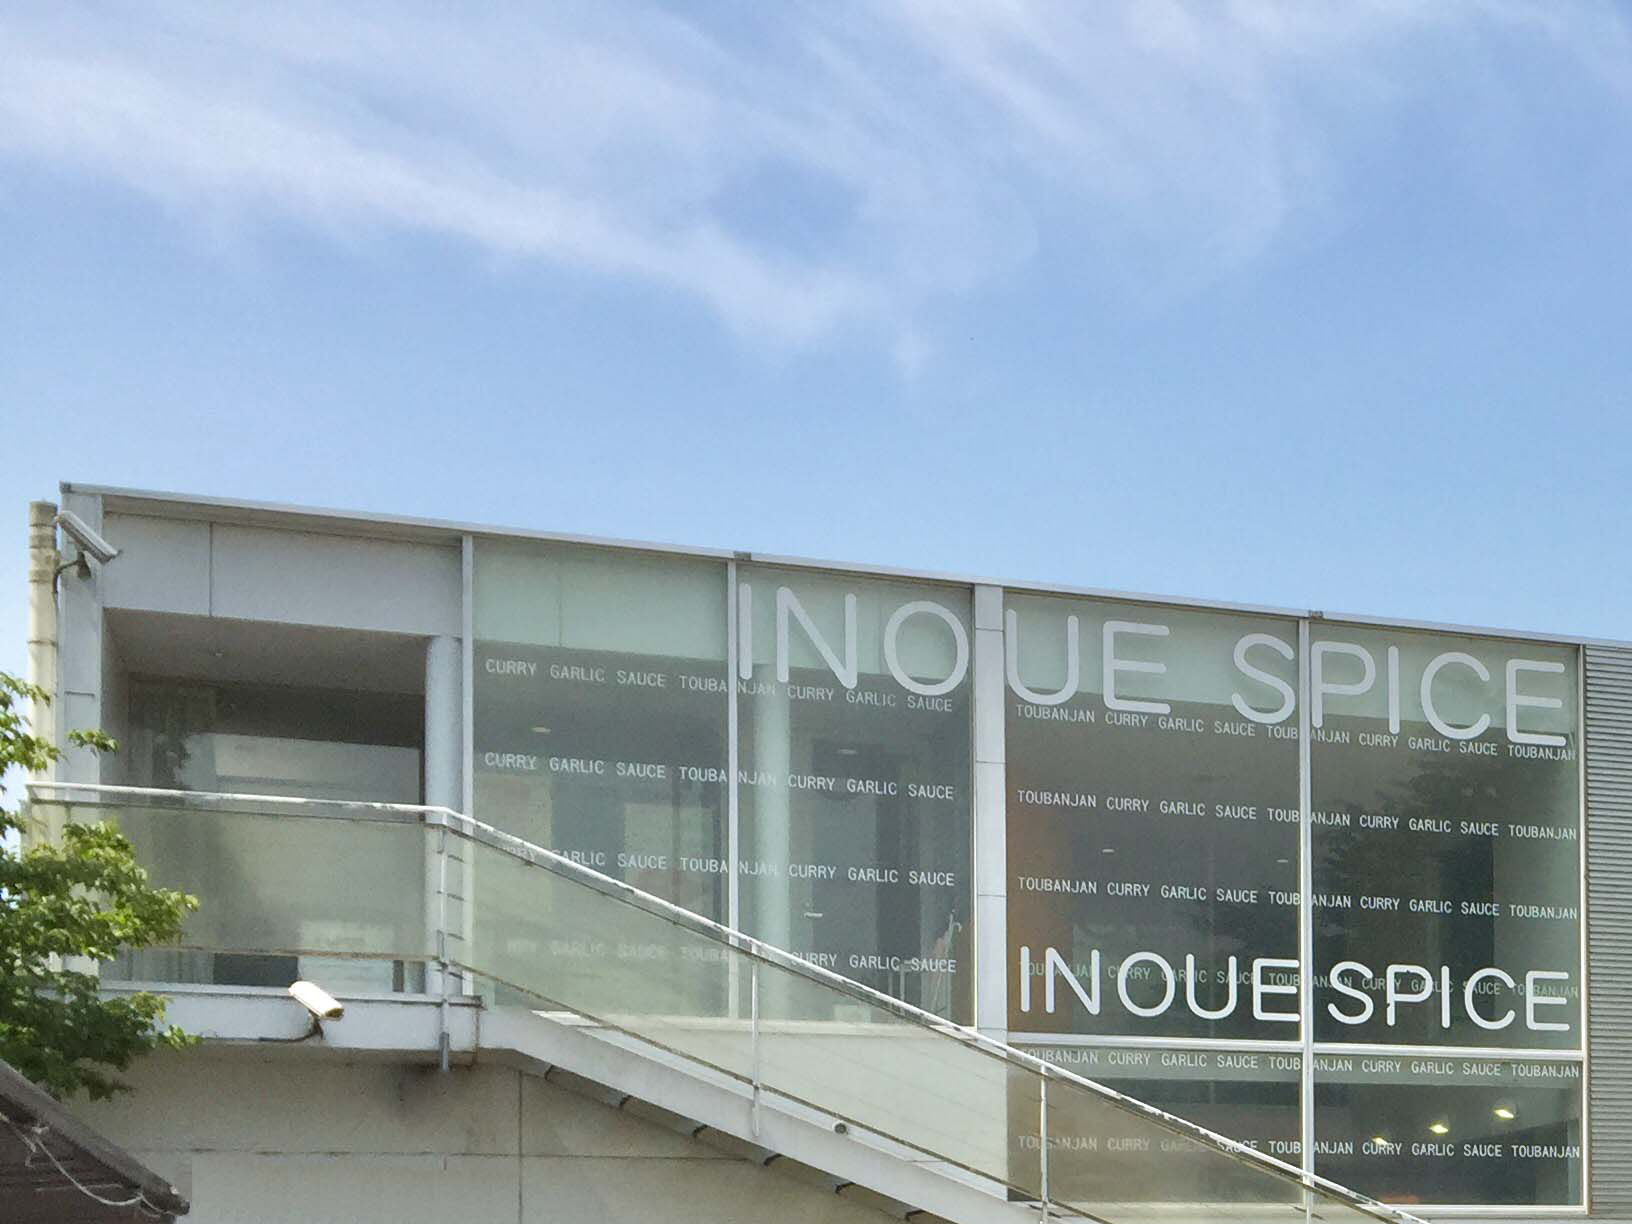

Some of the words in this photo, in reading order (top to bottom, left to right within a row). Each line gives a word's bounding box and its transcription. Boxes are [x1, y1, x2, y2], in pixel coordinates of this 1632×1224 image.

[739, 583, 1171, 714] INOUE
[1231, 634, 1566, 746] SPICE
[486, 659, 537, 676] CURRY
[550, 664, 605, 682] GARLIC
[616, 670, 666, 687] SAUCE
[787, 686, 834, 701] CURRY
[846, 691, 896, 706] GARLIC
[908, 695, 952, 712] SAUCE
[1016, 704, 1095, 723] TOUBANJAN
[1105, 712, 1148, 728] CURRY
[1158, 716, 1204, 733] GARLIC
[1214, 721, 1256, 737] SAUCE
[1359, 732, 1398, 748] CURRY
[1408, 737, 1450, 752] GARLIC
[1459, 741, 1498, 756] SAUCE
[1508, 745, 1576, 761] TOUBANJAN
[485, 752, 537, 770] CURRY
[549, 757, 605, 775] GARLIC
[616, 762, 666, 779] SAUCE
[788, 774, 836, 791] CURRY
[847, 779, 897, 795] GARLIC
[908, 784, 954, 800] SAUCE
[1018, 790, 1097, 808] TOUBANJAN
[1106, 797, 1149, 812] CURRY
[1160, 800, 1206, 816] GARLIC
[1215, 805, 1256, 820] SAUCE
[1359, 814, 1399, 829] CURRY
[1409, 818, 1451, 833] GARLIC
[1460, 821, 1499, 836] SAUCE
[1508, 824, 1577, 841] TOUBANJAN
[617, 853, 667, 870] SAUCE
[789, 863, 836, 879] CURRY
[848, 867, 898, 883] GARLIC
[909, 871, 955, 886] SAUCE
[1019, 876, 1097, 894] TOUBANJAN
[1107, 882, 1150, 897] CURRY
[1161, 885, 1207, 901] GARLIC
[1216, 889, 1258, 904] SAUCE
[1360, 896, 1400, 911] CURRY
[1409, 899, 1452, 914] GARLIC
[1461, 902, 1500, 917] SAUCE
[1509, 904, 1578, 920] TOUBANJAN
[849, 954, 900, 971] GARLIC
[910, 957, 957, 973] SAUCE
[1020, 946, 1300, 1022] INOUE
[1328, 961, 1570, 1031] SPICE
[1108, 1052, 1151, 1066] CURRY
[1161, 1053, 1207, 1067] GARLIC
[1217, 1055, 1258, 1069] SAUCE
[1362, 1060, 1401, 1073] CURRY
[1411, 1061, 1454, 1075] GARLIC
[1463, 1063, 1501, 1076] SAUCE
[1512, 1064, 1579, 1078] TOUBANJAN
[1411, 1144, 1455, 1157] GARLIC
[1463, 1144, 1502, 1157] SAUCE
[1512, 1145, 1580, 1158] TOUBANJAN
